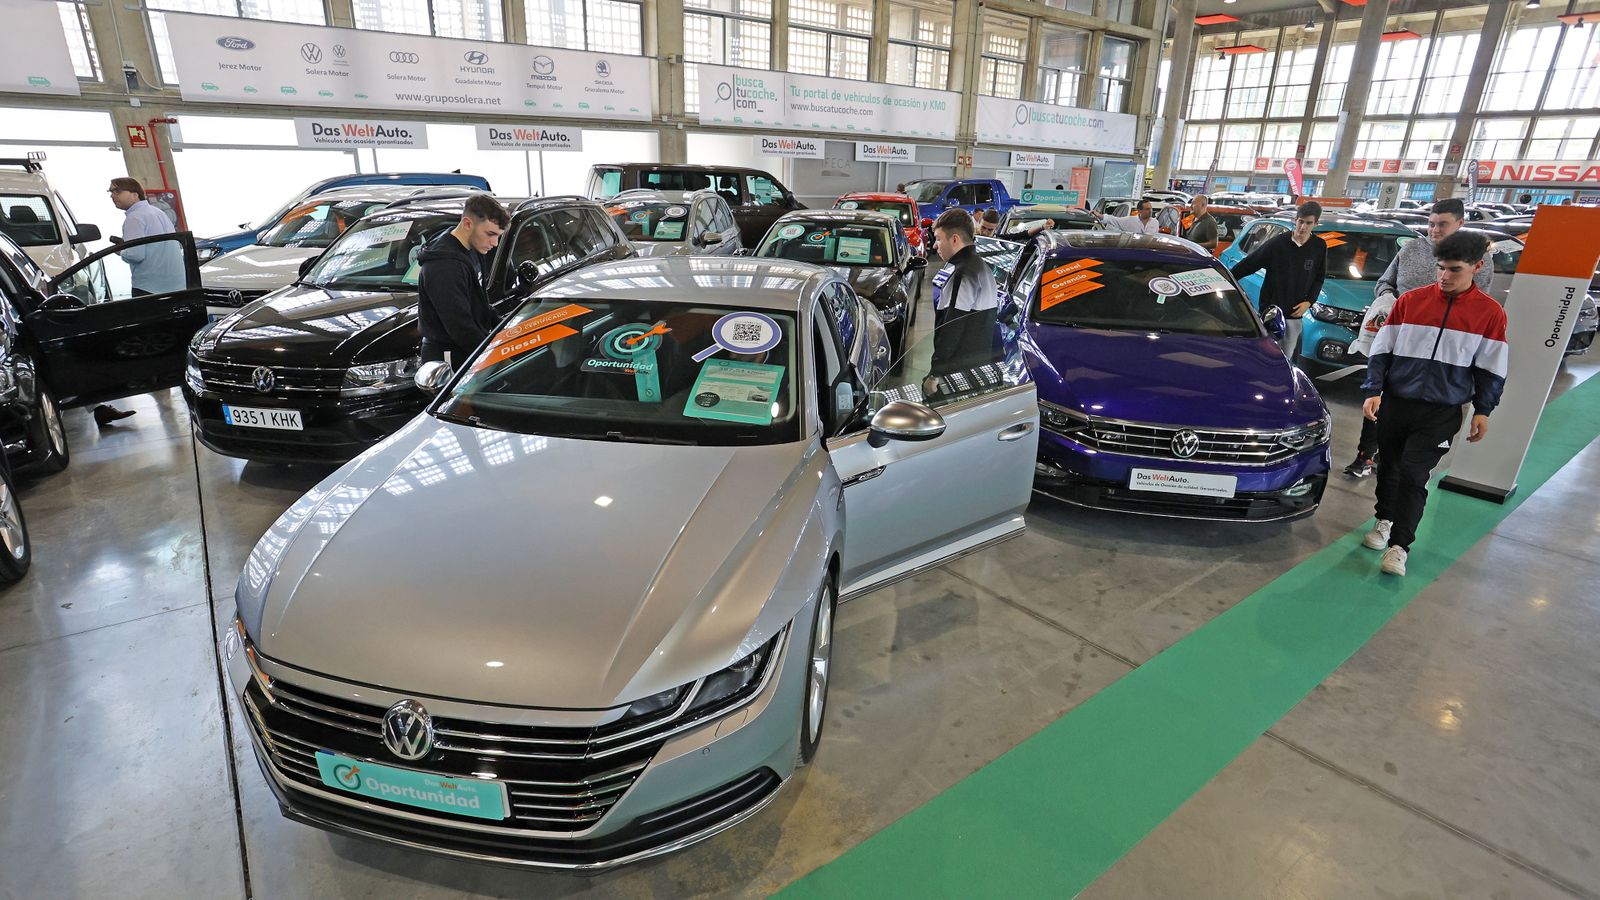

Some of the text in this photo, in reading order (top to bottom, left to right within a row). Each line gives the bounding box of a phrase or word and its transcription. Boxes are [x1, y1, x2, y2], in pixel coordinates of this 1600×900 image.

[224, 38, 248, 49] Ford
[218, 62, 262, 72] Jerez Motor
[305, 68, 328, 76] Solera
[460, 66, 495, 74] HYUNDAI
[386, 73, 407, 81] Solera
[484, 79, 502, 87] Motor
[735, 74, 764, 88] busca
[395, 93, 502, 106] www.gruposolera.net
[736, 87, 778, 102] tucoche.
[790, 85, 800, 97] Tu
[803, 87, 829, 102] portal
[831, 90, 841, 100] de
[882, 95, 892, 106] de
[893, 97, 921, 108] ocasión
[922, 101, 928, 111] y
[790, 102, 873, 116] www.buscatucoche.com
[311, 122, 412, 138] Das WeltAuto.
[489, 128, 570, 142] Das WeltAuto.
[761, 138, 816, 151] Das WeltAuto.
[863, 144, 909, 155] Das WeltAuto.
[1016, 153, 1026, 161] Das
[1056, 263, 1081, 274] Diesel
[1051, 274, 1087, 289] Gerencia
[1175, 271, 1206, 281] busca
[1188, 284, 1212, 293] com
[524, 311, 568, 330] CERTIFICADO
[1544, 286, 1576, 348] Oportunidad
[501, 334, 542, 356] Diesel
[587, 359, 654, 370] Oportunidad
[232, 409, 299, 428] 9351 KHK
[1136, 472, 1189, 484] Das WeltAuto.
[424, 778, 440, 787] Das
[365, 776, 480, 810] Oportunidad
